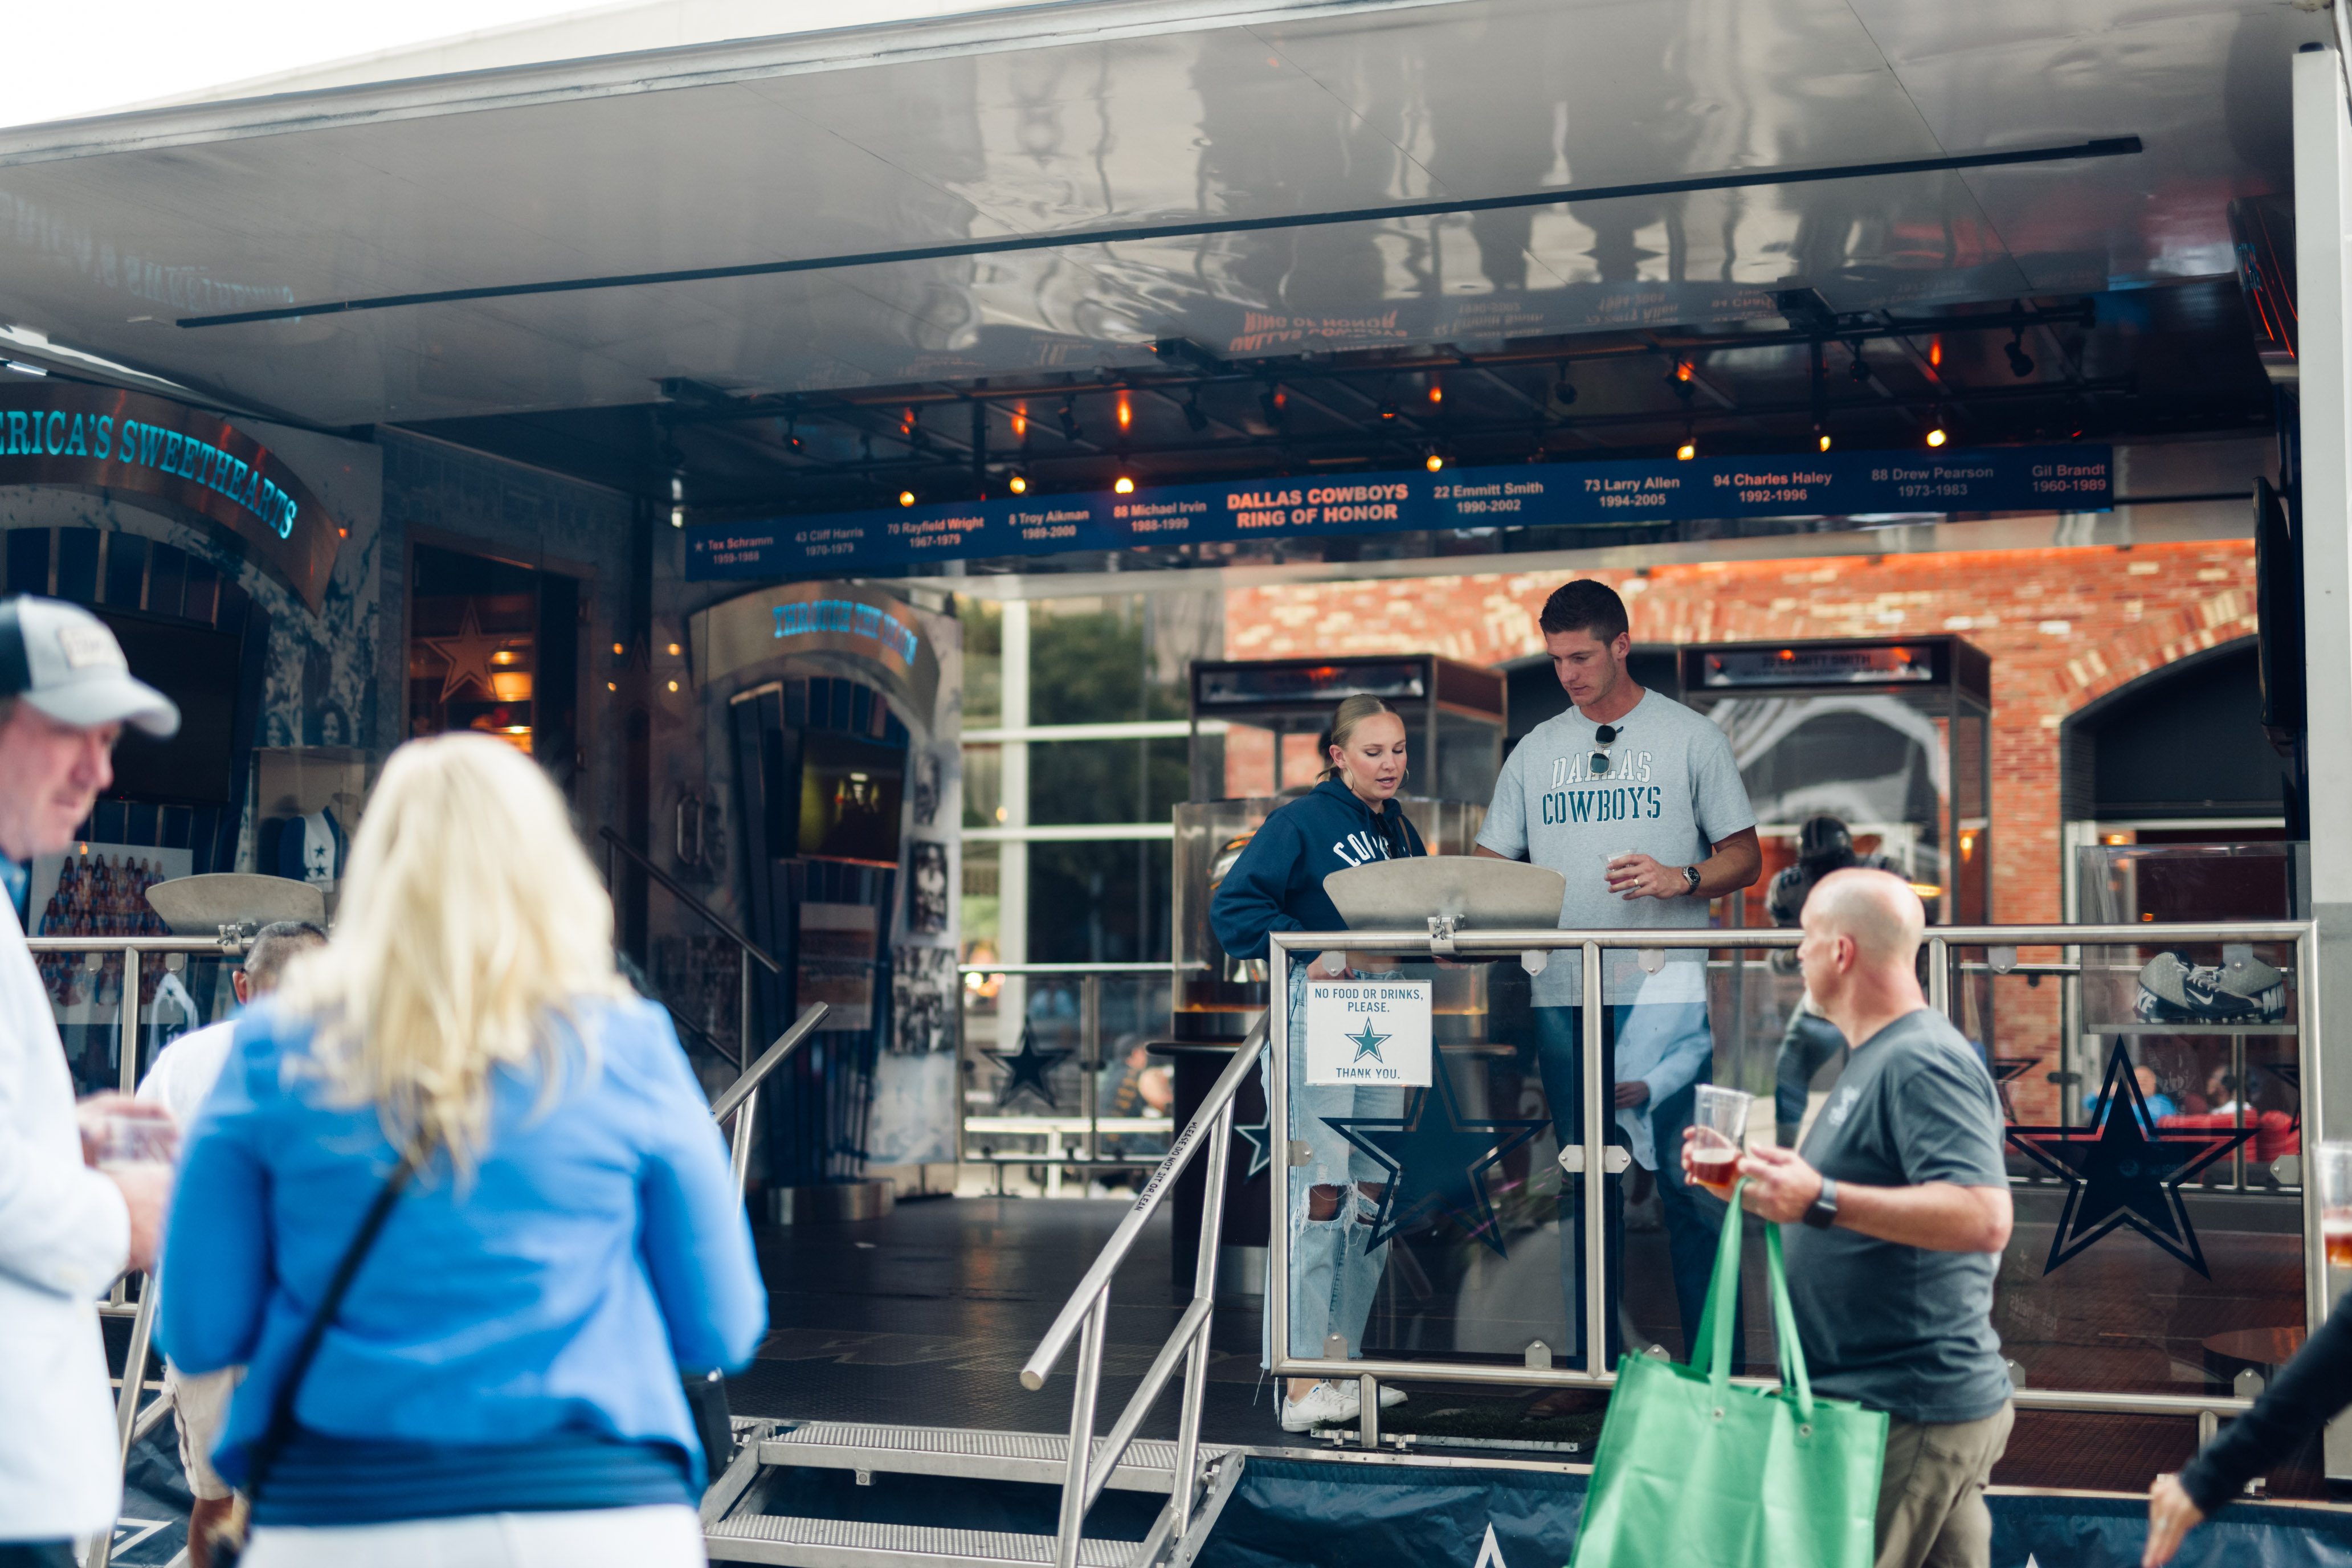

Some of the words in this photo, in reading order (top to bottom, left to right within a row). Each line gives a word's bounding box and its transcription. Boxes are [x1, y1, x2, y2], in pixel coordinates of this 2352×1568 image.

[0, 410, 114, 460] RICA'S
[119, 419, 298, 540] SWEETHEARTS
[1871, 469, 1888, 481] 88
[1892, 468, 1930, 480] Drew
[1934, 467, 1994, 479] Pearson
[2032, 465, 2052, 477] Gil
[2056, 463, 2106, 476] Brandt
[1584, 479, 1600, 492] 73
[1604, 478, 1641, 493] Larry
[1644, 476, 1680, 489] Allen
[1713, 474, 1730, 487] 94
[1734, 472, 1788, 486] Charles
[1792, 471, 1832, 487] Haley
[2032, 479, 2106, 492] 1960-1989
[1227, 491, 1302, 510] DALLAS
[1308, 483, 1408, 504] COWBOYS
[1433, 485, 1450, 499] 22
[1453, 483, 1501, 497] Emmitt
[1504, 481, 1544, 495] Smith
[1738, 488, 1808, 503] 1992-1996
[1898, 484, 1968, 497] 1973-1983
[1456, 499, 1521, 513] 1990-2002
[1599, 493, 1666, 508] 1994-2005
[1113, 505, 1128, 518] 88
[1130, 502, 1177, 517] Michael
[1179, 500, 1207, 513] Irvin
[1236, 510, 1287, 529] RING
[1291, 508, 1318, 524] OF
[1323, 504, 1398, 523] HONOR
[1008, 513, 1016, 526] 8
[1018, 512, 1045, 526] Troy
[1046, 510, 1090, 523] Aikman
[1130, 517, 1189, 532] 1988-1999
[887, 523, 900, 535] 70
[901, 519, 946, 535] Rayfield
[947, 517, 985, 532] Wright
[1022, 525, 1076, 540] 1989-2000
[794, 531, 807, 542] 43
[809, 529, 831, 541] Cliff
[832, 526, 864, 540] Harris
[909, 533, 961, 548] 1967-1979
[708, 539, 724, 551] Tex
[726, 536, 774, 549] Schramm
[1542, 785, 1662, 826] COWBOYS
[1314, 988, 1329, 999] NO
[1333, 988, 1359, 999] FOOD
[1363, 989, 1377, 999] OR
[1381, 989, 1424, 1001] DRINKS,
[1348, 1002, 1390, 1012] PLEASE.
[1336, 1068, 1371, 1079] THANK
[1375, 1068, 1400, 1079] YOU.
[1178, 1122, 1197, 1146] PLEASE
[1171, 1146, 1183, 1155] DO
[1162, 1157, 1176, 1171] NOT
[1154, 1171, 1166, 1183] SIT
[1147, 1183, 1158, 1193] OR
[1134, 1193, 1152, 1211] LEAN
